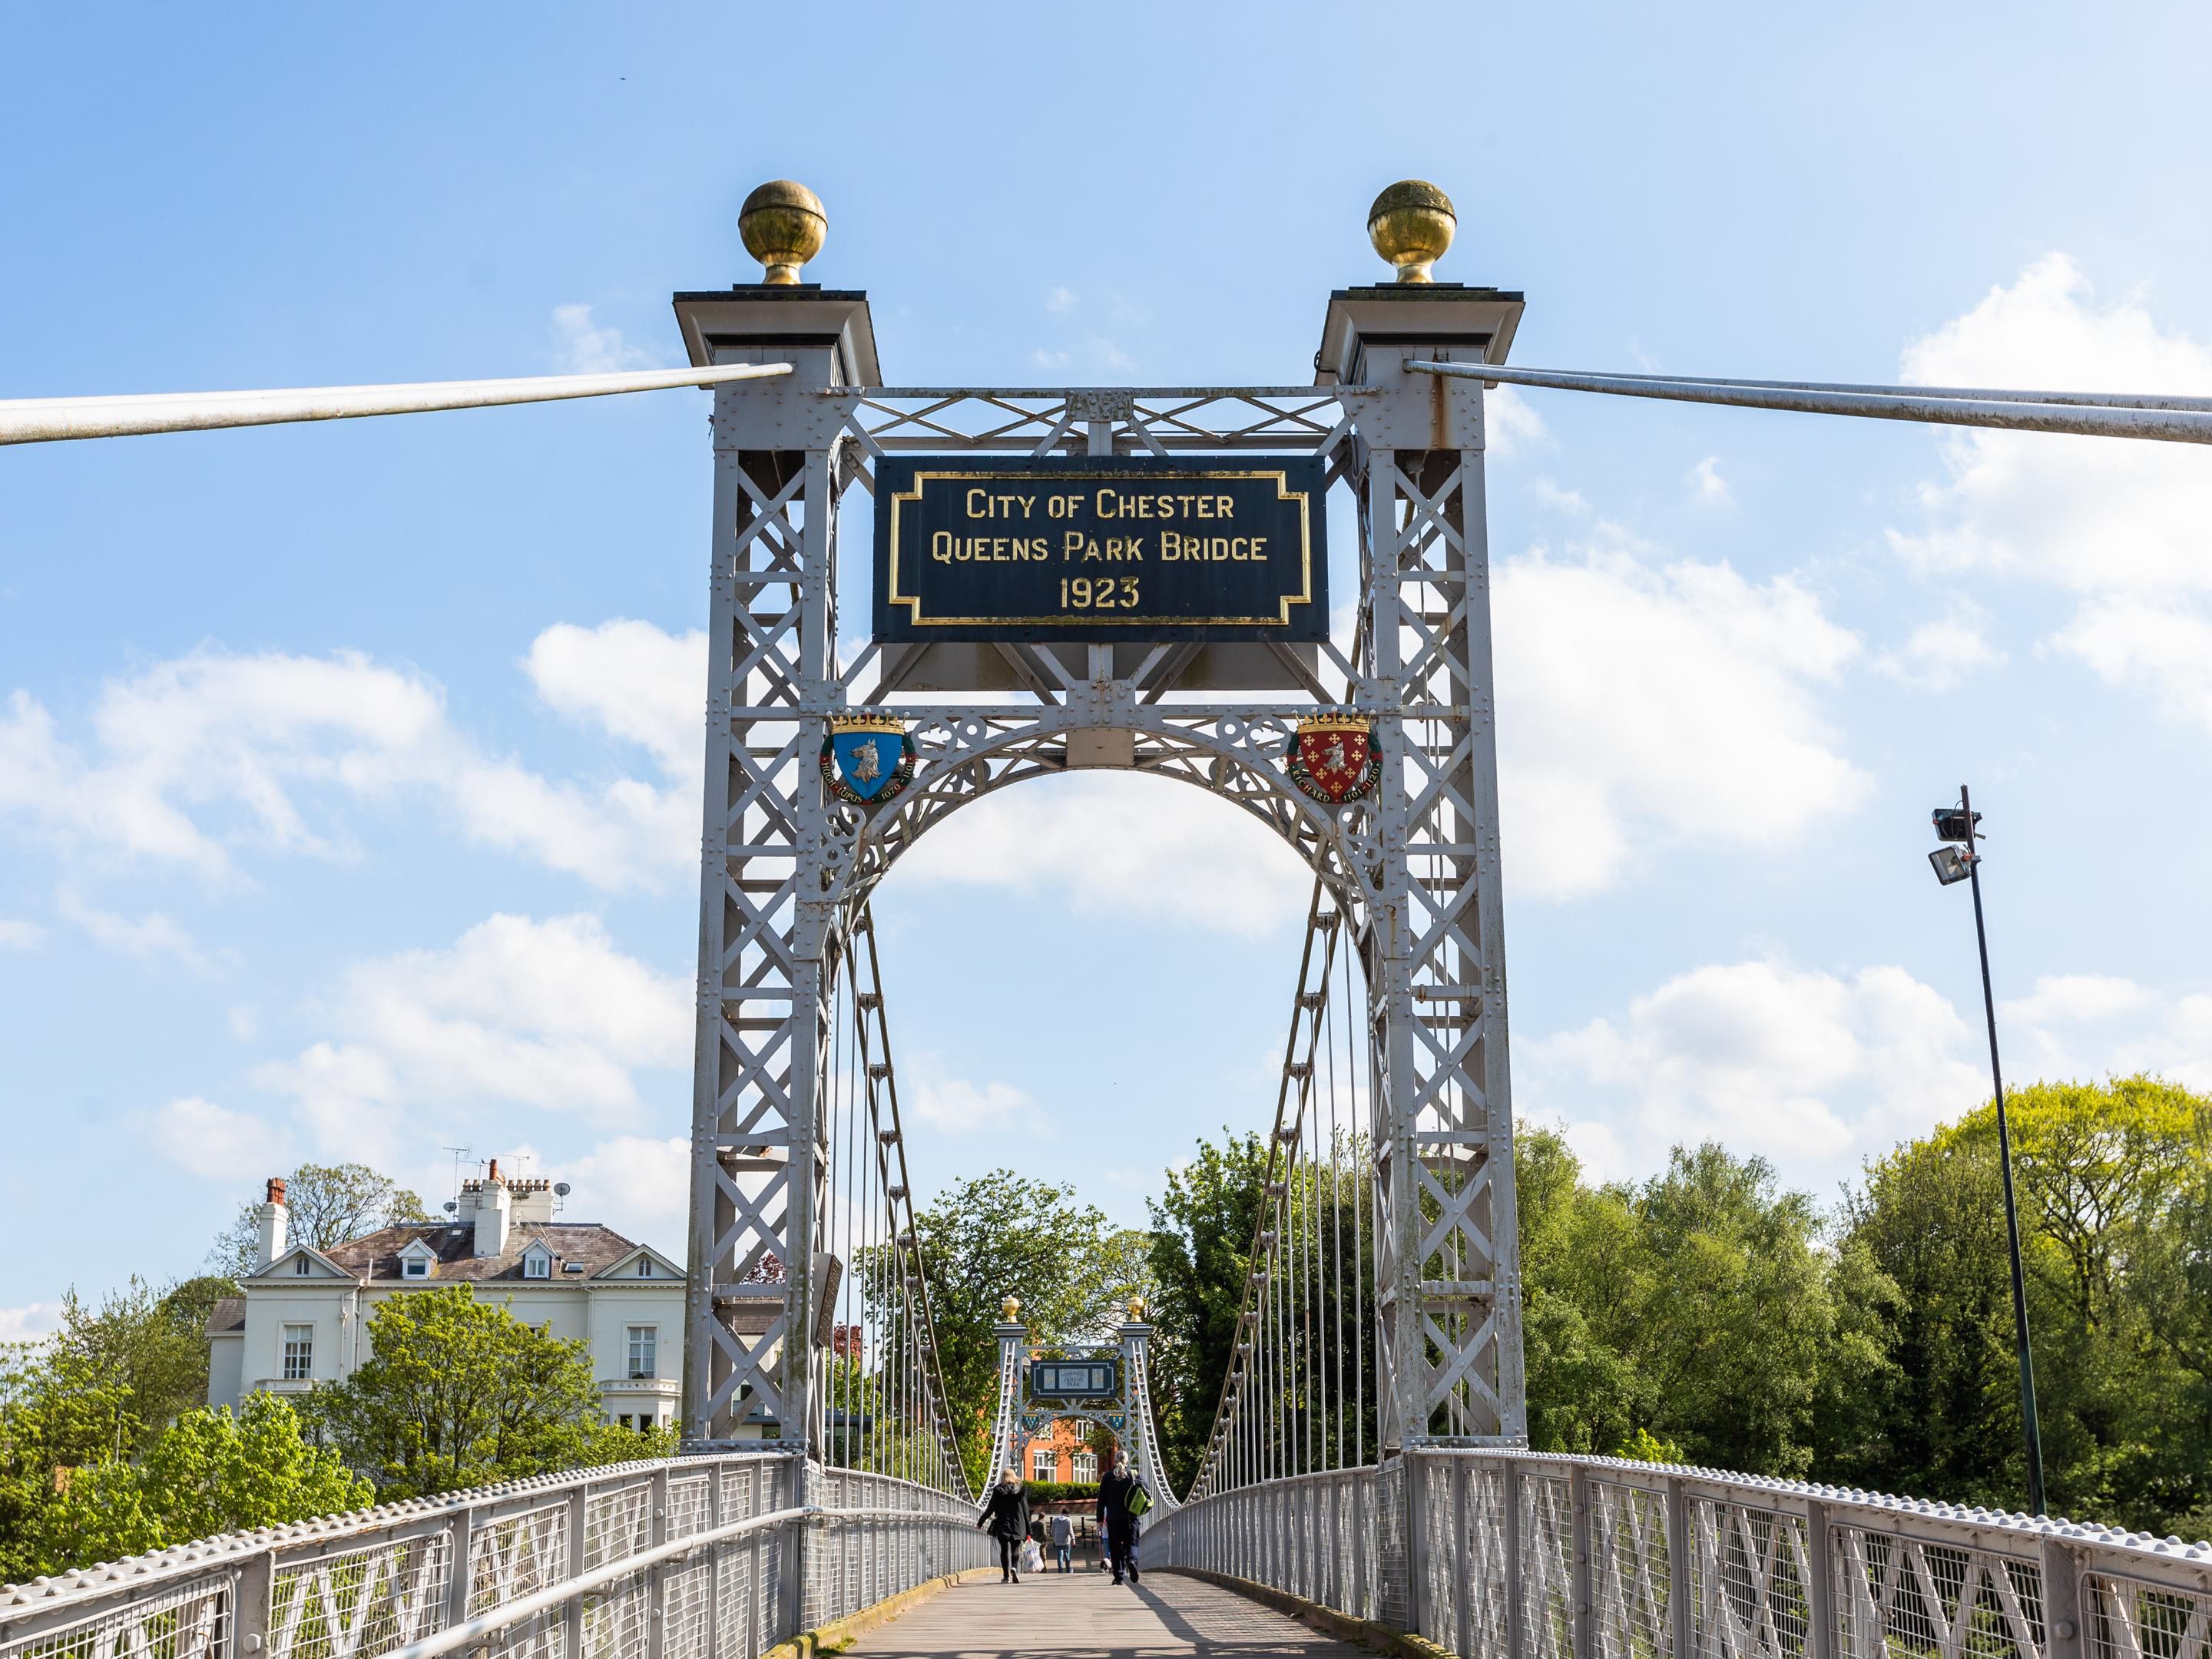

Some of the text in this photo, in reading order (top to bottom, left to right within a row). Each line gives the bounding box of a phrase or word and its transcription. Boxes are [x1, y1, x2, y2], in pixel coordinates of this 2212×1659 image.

[966, 488, 1234, 518] CITY OF CHESTER
[932, 531, 1267, 565] QUEENS PARK BRIDGE
[1061, 577, 1139, 608] 1923
[821, 762, 836, 787] HUGH
[836, 786, 863, 803] LUPUS
[1292, 770, 1330, 803] RICHARD
